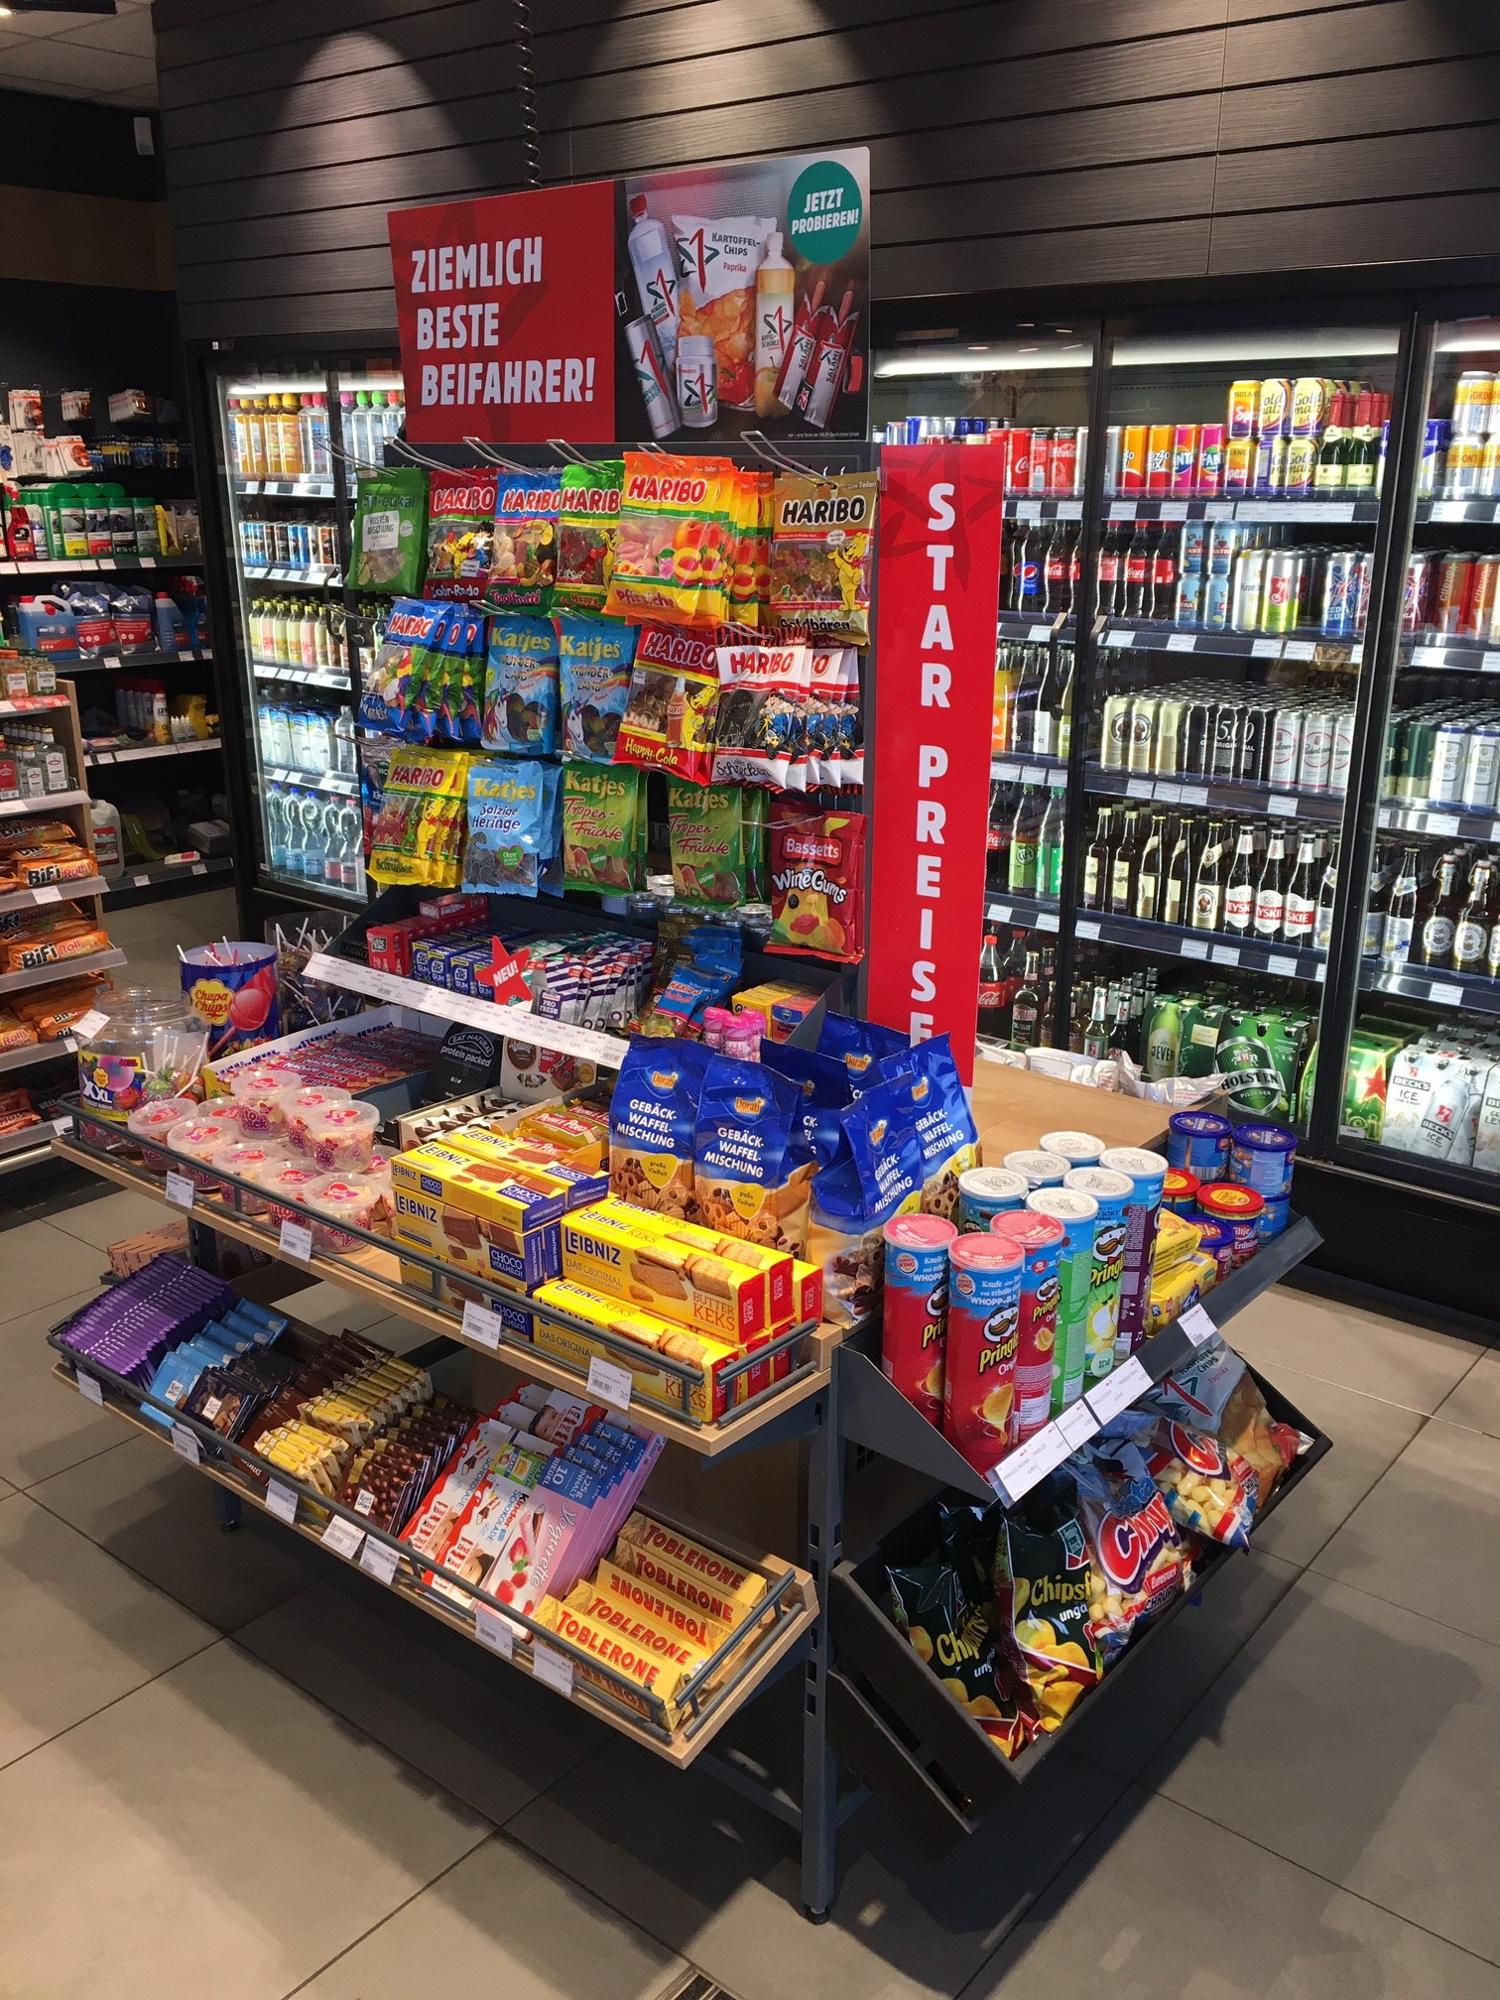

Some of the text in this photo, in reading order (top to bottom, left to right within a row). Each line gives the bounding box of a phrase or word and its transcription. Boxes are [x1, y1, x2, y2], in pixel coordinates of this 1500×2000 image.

[804, 187, 844, 214] JETZT
[791, 207, 859, 235] PROBIEREN!
[712, 232, 760, 247] KARTOFFEL-
[724, 245, 748, 256] CHIPS
[411, 236, 543, 294] ZIEMLICH
[723, 262, 747, 273] Paprika
[417, 302, 500, 350] BESTE
[420, 357, 596, 406] BEIFAHRER!
[433, 486, 496, 512] HARIBO
[561, 487, 622, 514] HARIB
[627, 476, 708, 505] HARIBO
[781, 496, 866, 526] HARIBO
[490, 627, 551, 652] Katjes
[559, 635, 620, 662] Katjes
[643, 631, 717, 671] HARIBO
[730, 652, 796, 676] HARIBO
[390, 766, 446, 788] HARIBO
[473, 777, 537, 801] Katjes
[565, 769, 626, 799] Katjes
[480, 803, 519, 818] Salzige
[563, 797, 616, 818] Tropen-
[668, 788, 730, 814] Katjes
[472, 816, 521, 833] Heringe
[670, 814, 720, 834] Tropen-
[785, 838, 840, 858] Bassetts
[28, 865, 60, 886] BiFi
[1228, 902, 1251, 914] TYSK
[1287, 911, 1309, 924] SKIE
[22, 940, 81, 969] BiFi Roll
[493, 960, 519, 986] NEU!
[195, 988, 228, 1001] Chupa
[2, 1029, 25, 1046] Roll
[440, 1045, 493, 1067] protein packed
[1151, 1046, 1175, 1061] JEVER
[1221, 1071, 1279, 1091] HOLSTEN
[735, 1098, 763, 1115] Dorati
[1399, 1089, 1419, 1101] ICE
[629, 1098, 678, 1121] GEBÄCK-
[915, 1108, 949, 1132] GEBÄCK-
[628, 1113, 673, 1134] WAFFEL-
[921, 1123, 954, 1144] WAFFEL-
[464, 1129, 515, 1150] LEIBNIZ
[616, 1122, 676, 1150] MISCHUNG
[717, 1127, 765, 1149] GEBÄCK-
[923, 1129, 965, 1160] MISCHUNG
[1426, 1132, 1443, 1145] ICE
[416, 1143, 471, 1165] LEIBNIZ
[718, 1140, 762, 1163] WAFFEL-
[392, 1163, 417, 1181] LEIBNIZ
[704, 1150, 764, 1178] MISCHUNG
[874, 1153, 901, 1182] GEBÄCK-
[879, 1169, 904, 1194] WAFFEL-
[874, 1175, 914, 1214] MISCHUNG
[394, 1191, 438, 1223] LEIBNIZ
[579, 1209, 631, 1232] LEIBNIZ
[565, 1226, 622, 1266] LEIBNIZ
[490, 1249, 523, 1270] CHOCO
[899, 1261, 916, 1269] KING
[912, 1272, 944, 1282] WHOPP
[981, 1280, 1003, 1288] Kaufe
[692, 1291, 735, 1316] BUTTER
[693, 1304, 736, 1332] KEKS
[538, 1328, 593, 1358] DAS ORIGINA
[552, 1465, 568, 1486] 10
[485, 1490, 523, 1543] SCHOKOLADE
[505, 1493, 530, 1529] Kinder
[642, 1524, 746, 1591] TOBLERONE
[634, 1551, 735, 1624] TOBLERONE
[1030, 1571, 1092, 1607] Chipsf
[610, 1573, 707, 1647] TOBLERONE
[586, 1596, 693, 1667] TOBLERONE
[555, 1609, 661, 1686] TOBLERONE
